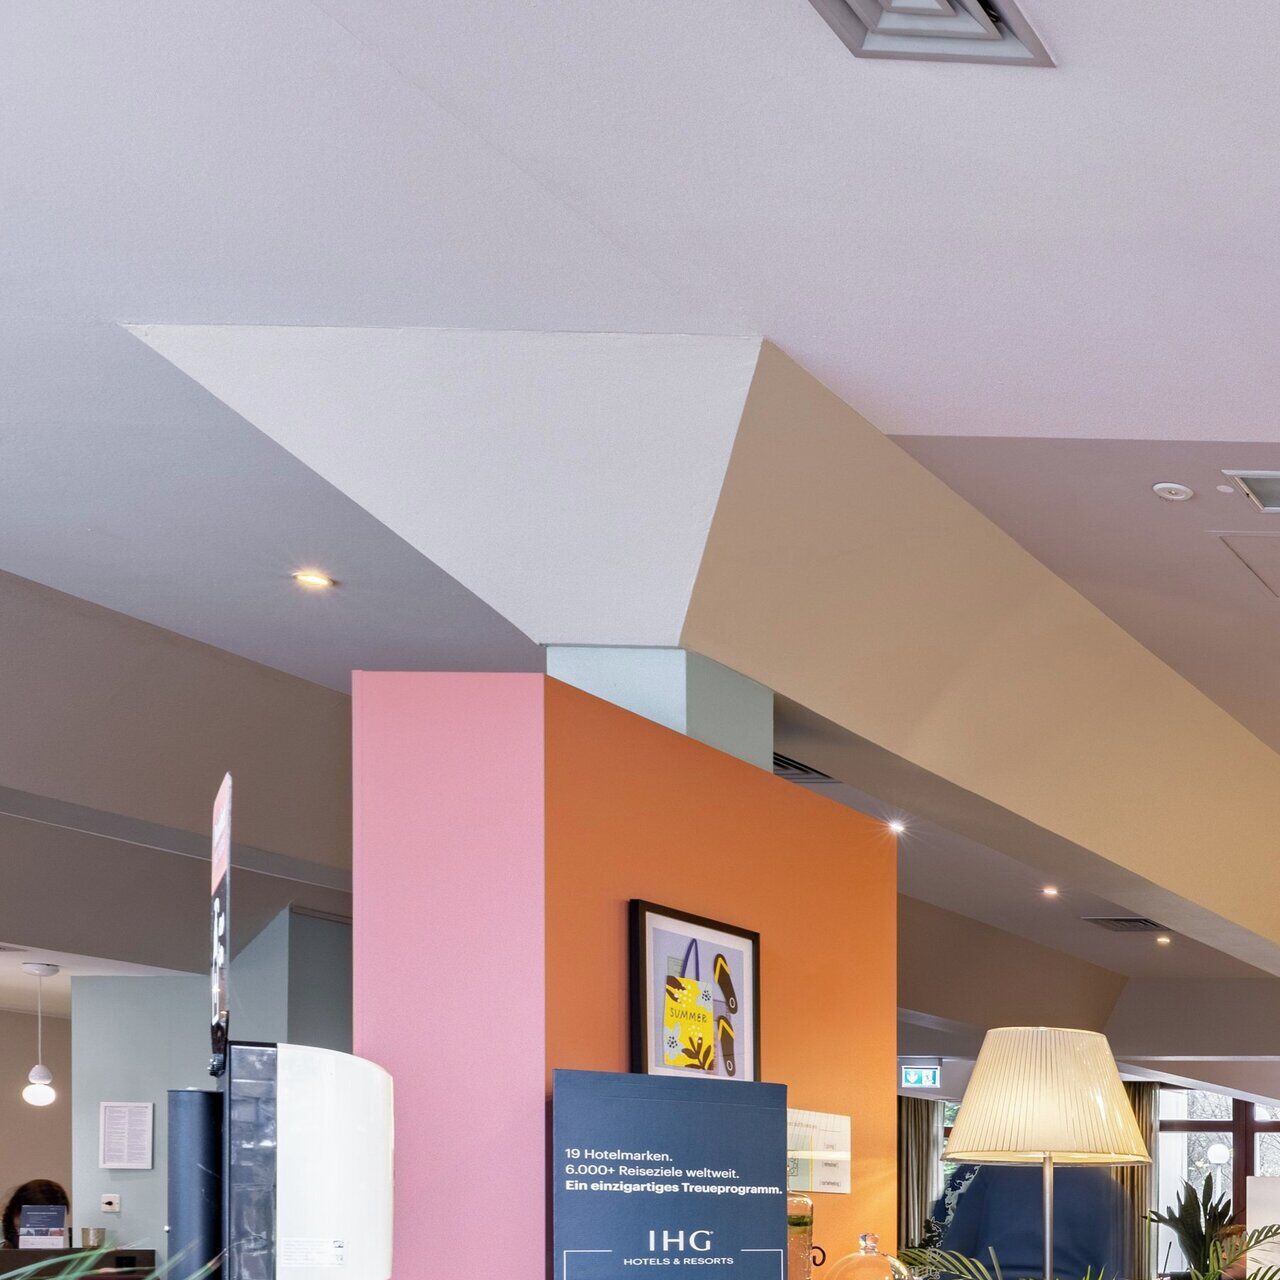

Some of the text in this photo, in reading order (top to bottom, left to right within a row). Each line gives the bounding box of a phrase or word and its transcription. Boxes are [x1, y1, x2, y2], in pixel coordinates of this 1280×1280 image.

[670, 1008, 707, 1023] SUMMER
[565, 1148, 673, 1162] 19 Hotelmarken.
[565, 1164, 740, 1179] 6.000+ Reiseziele weltweit.
[565, 1180, 783, 1195] Ein einzigartiges Treueprogramm.
[649, 1230, 713, 1251] IHG
[624, 1257, 734, 1266] HOTELS & RESORTS
